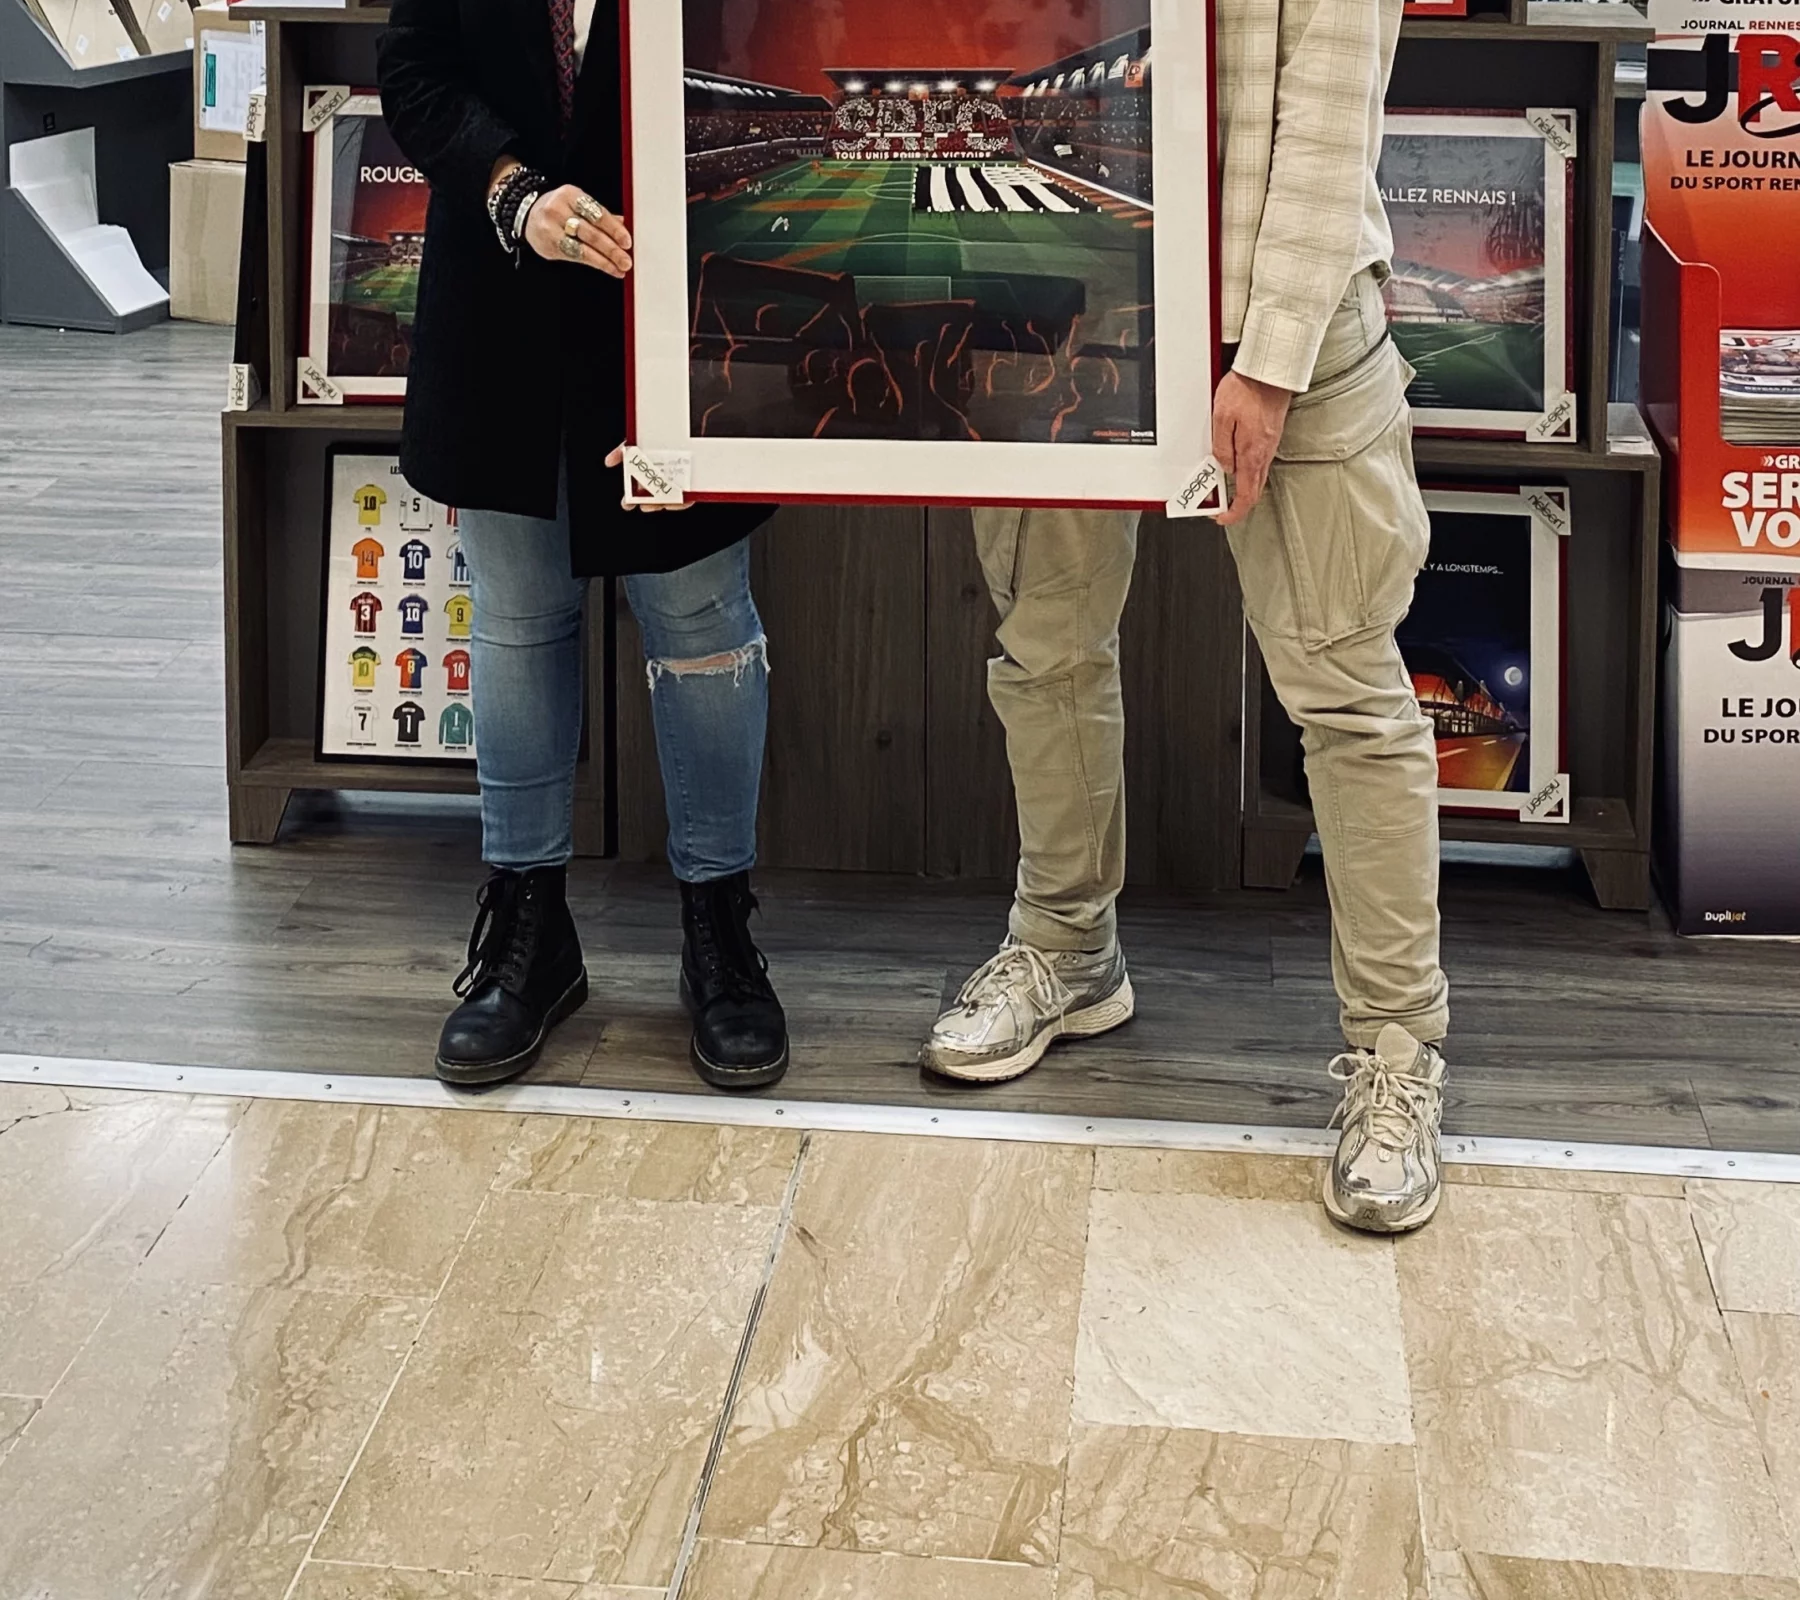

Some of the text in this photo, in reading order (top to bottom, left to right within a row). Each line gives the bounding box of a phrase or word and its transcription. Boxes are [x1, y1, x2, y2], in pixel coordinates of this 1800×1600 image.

[1680, 19, 1745, 30] JOURNAL
[836, 151, 863, 160] TOUS
[866, 152, 890, 160] UNIS
[1686, 150, 1714, 168] LE
[360, 166, 425, 183] ROUGE
[1670, 176, 1698, 190] DU
[1702, 176, 1766, 190] SPORT
[1380, 188, 1516, 206] ALLEZ RENNAIS !
[363, 496, 377, 511] 10
[412, 498, 421, 512] 5
[1730, 511, 1800, 548] VO
[407, 551, 422, 569] 10
[1436, 564, 1444, 572] A
[1742, 576, 1794, 585] JOURNAL
[360, 605, 370, 621] 3
[406, 608, 420, 622] 10
[456, 608, 464, 622] 9
[453, 662, 465, 678] 10
[1722, 698, 1800, 718] LE JO
[358, 713, 367, 730] 7
[406, 714, 411, 734] 1
[454, 711, 459, 727] 1
[1704, 728, 1800, 744] DU SPOR
